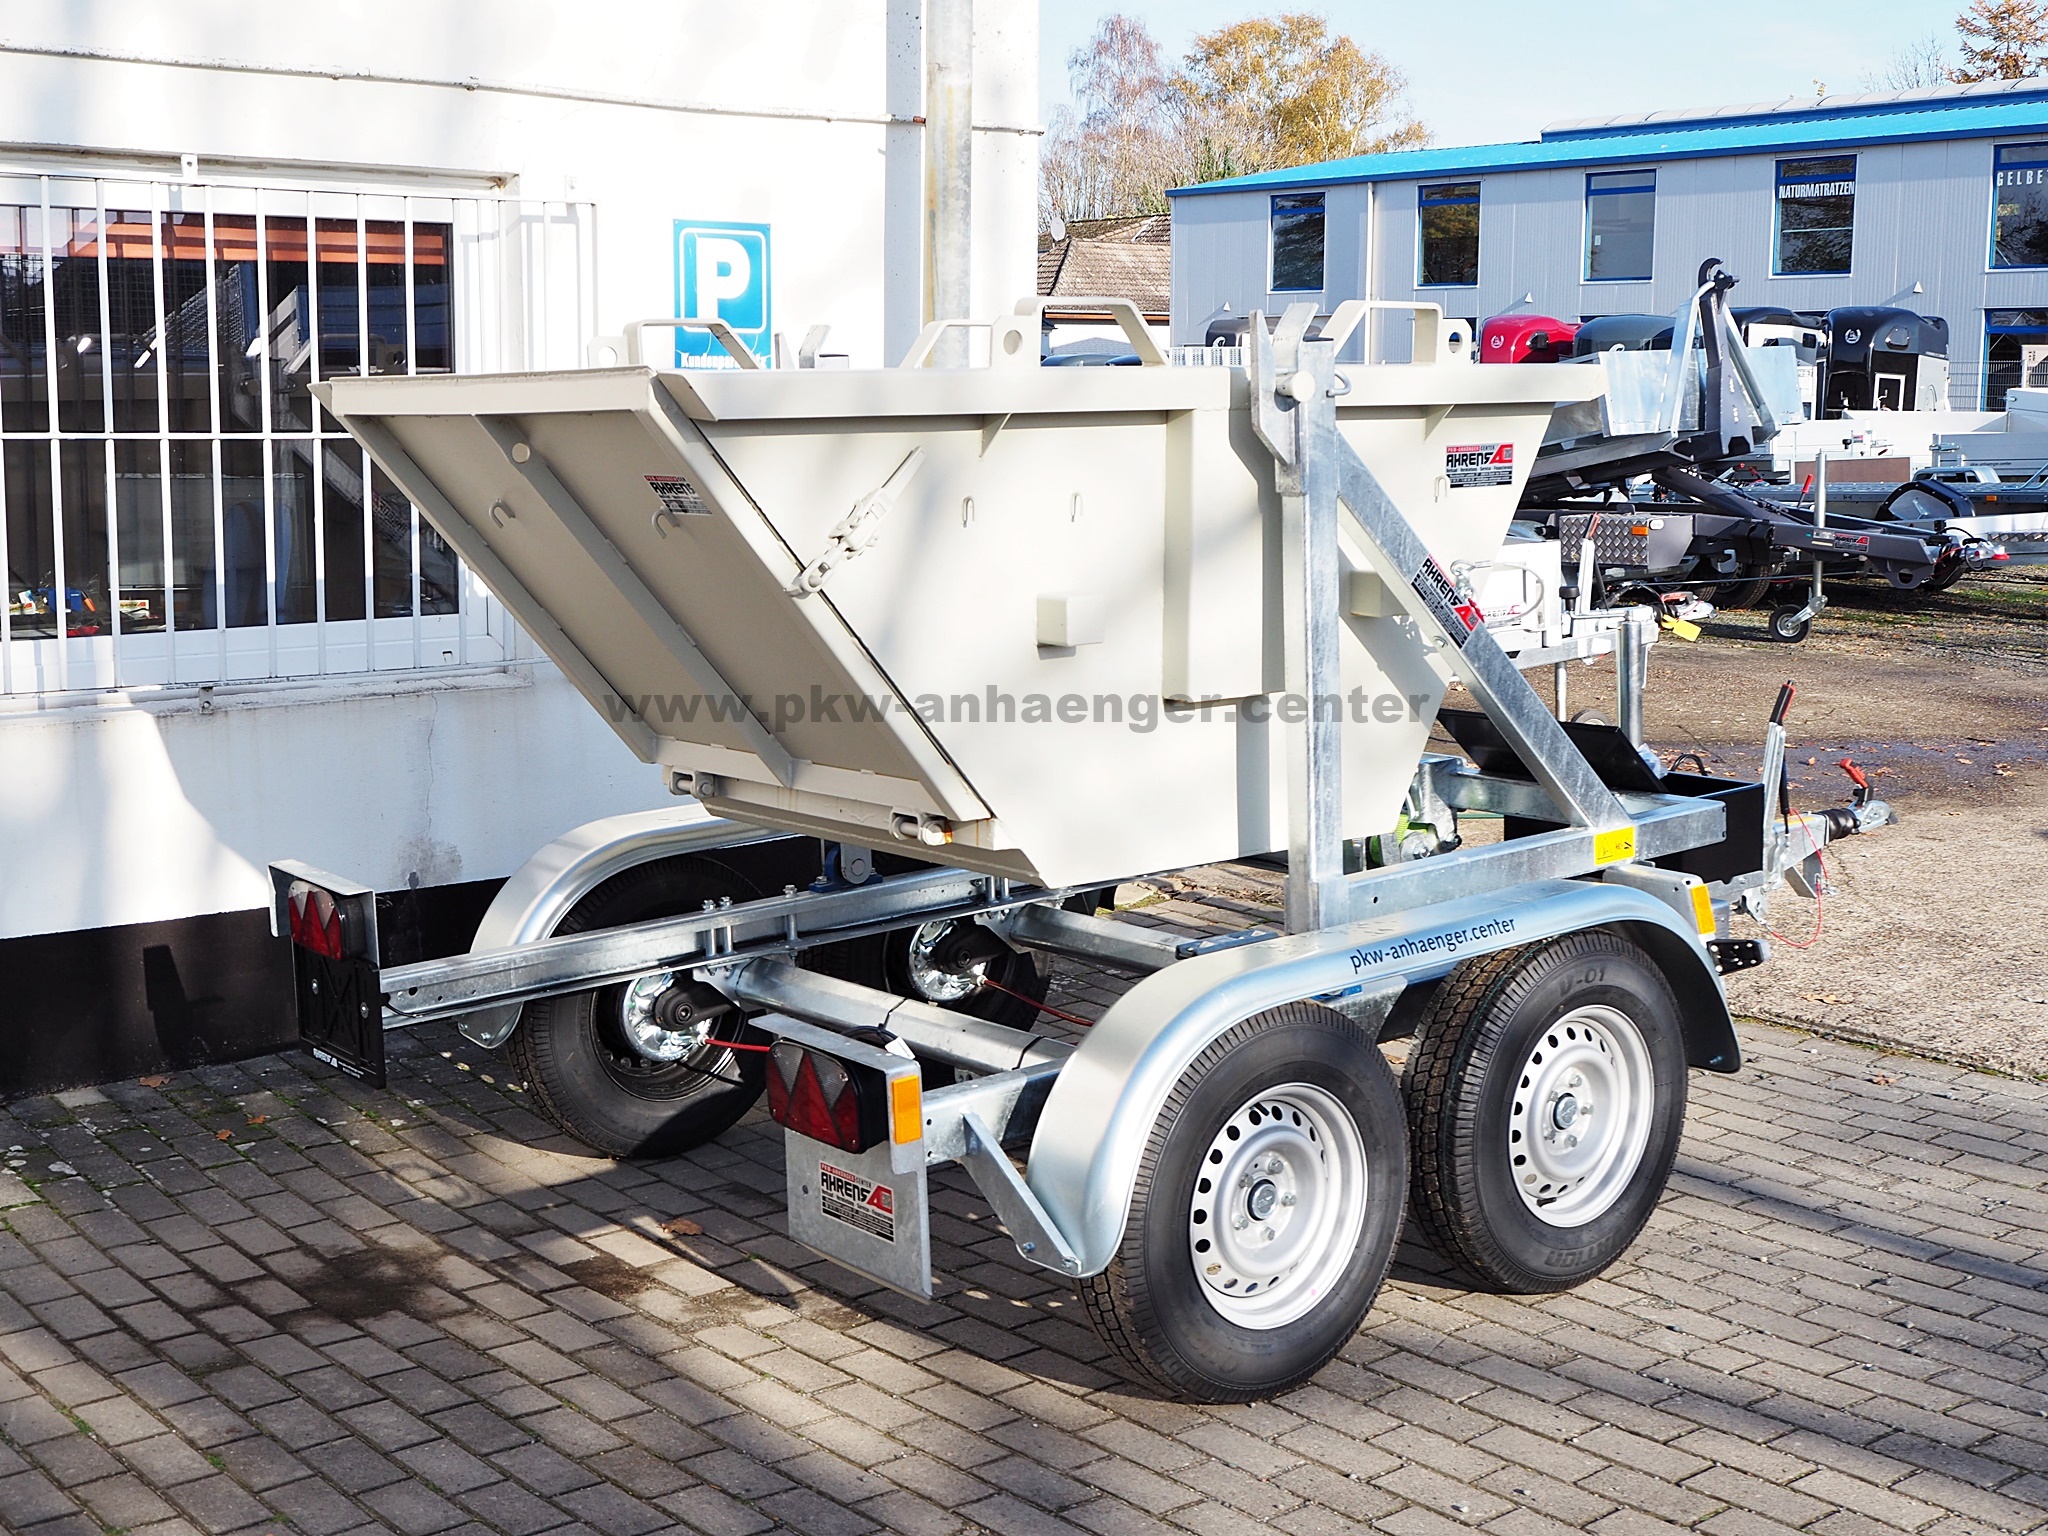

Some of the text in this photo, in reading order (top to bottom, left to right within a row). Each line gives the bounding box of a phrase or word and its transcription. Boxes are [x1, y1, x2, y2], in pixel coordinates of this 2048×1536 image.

[1778, 181, 1855, 199] NATURMATRATZEN
[1996, 169, 2048, 187] GELBE
[695, 236, 751, 319] P
[1446, 452, 1494, 468] AHRENS
[649, 481, 696, 496] AHRENS
[1421, 557, 1463, 606] AHRENS
[1349, 917, 1516, 975] pkw-anhaenger.center
[821, 1171, 871, 1202] AHRENS
